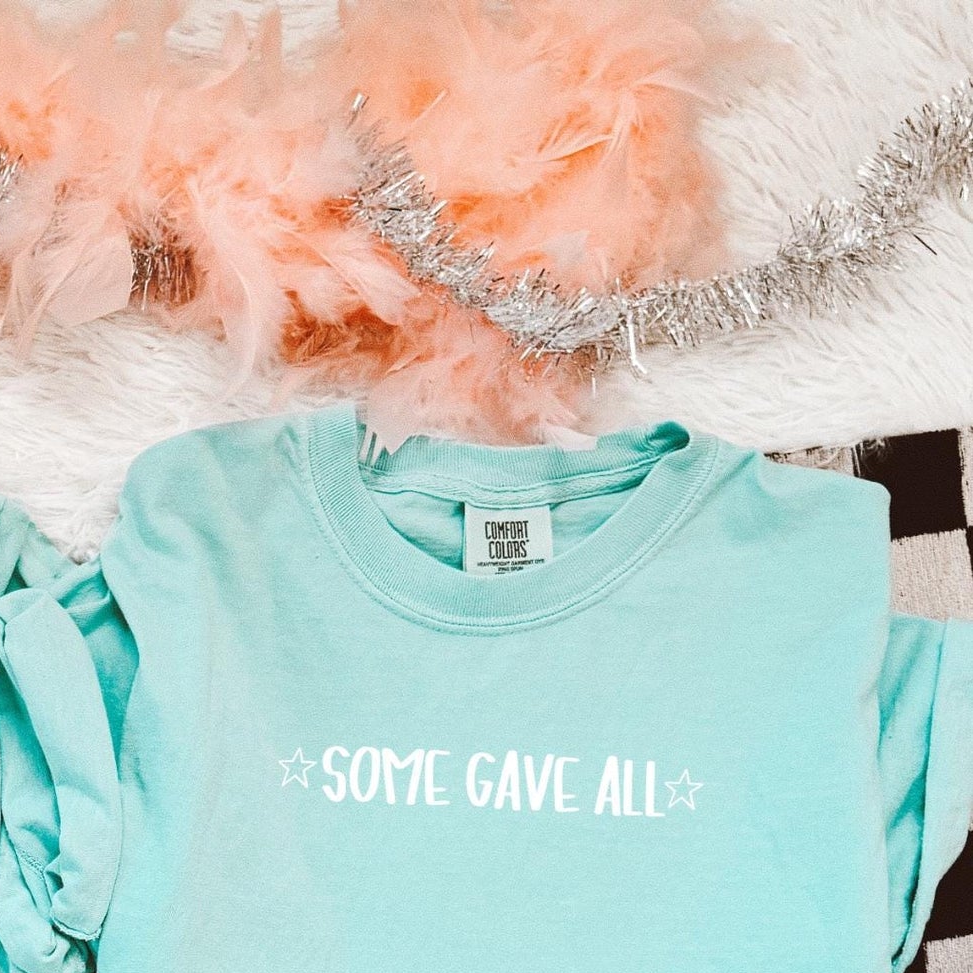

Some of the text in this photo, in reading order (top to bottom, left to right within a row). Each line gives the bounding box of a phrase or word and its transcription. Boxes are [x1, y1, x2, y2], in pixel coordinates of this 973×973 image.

[484, 520, 529, 540] COMFORT
[321, 745, 667, 818] SOME GAVE ALL
